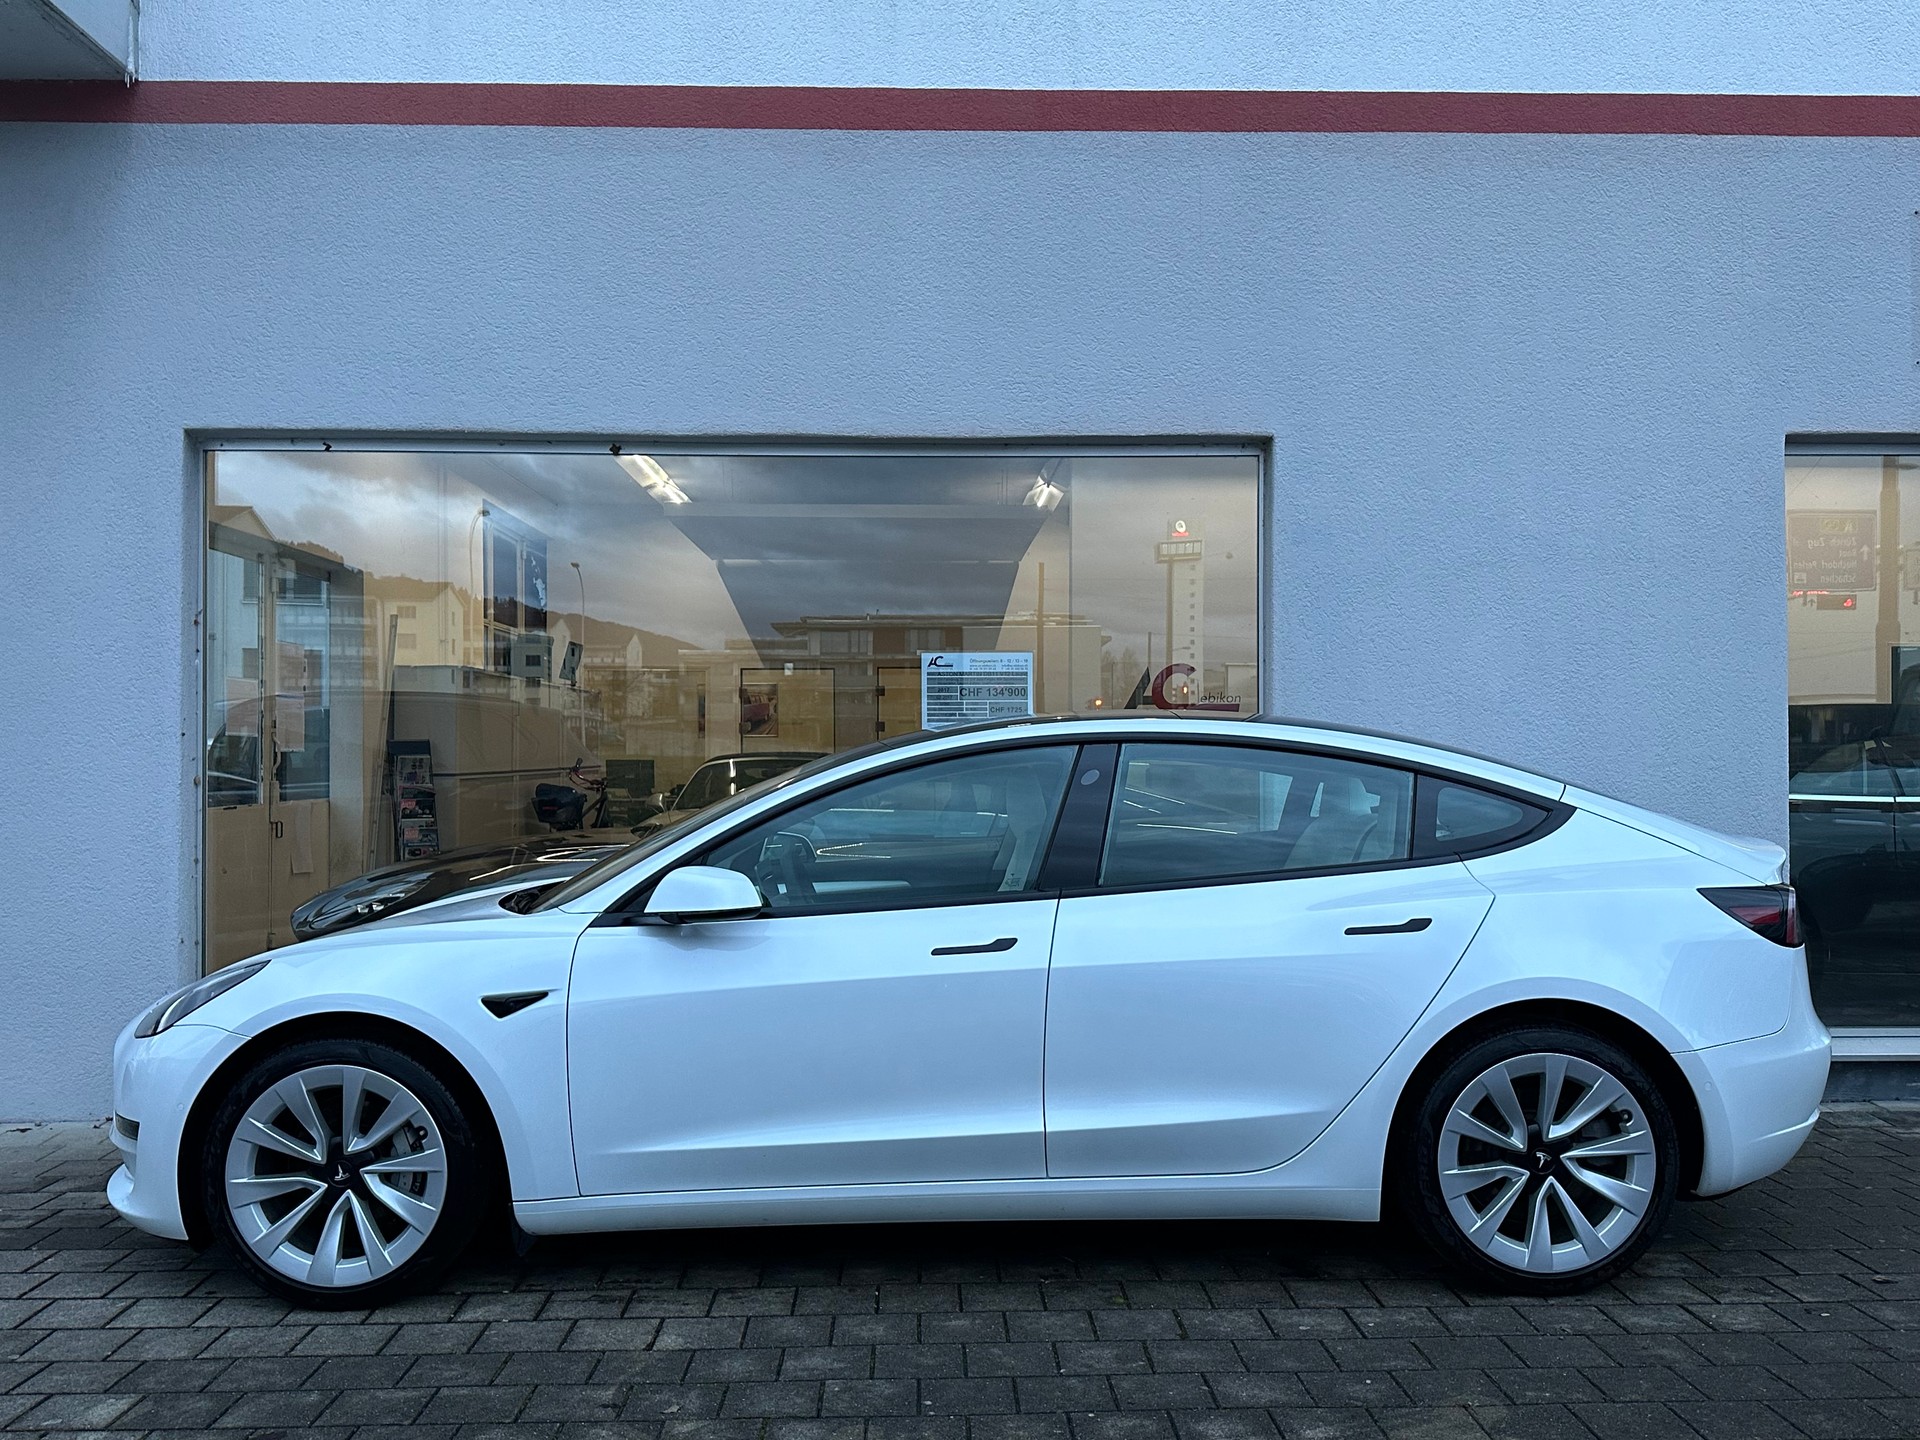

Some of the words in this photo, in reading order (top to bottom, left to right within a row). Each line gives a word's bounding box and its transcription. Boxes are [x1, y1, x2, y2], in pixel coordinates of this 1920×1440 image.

[928, 655, 953, 667] AC
[960, 688, 983, 697] CHF
[986, 687, 1026, 697] 134'900
[1200, 692, 1242, 704] ebikon
